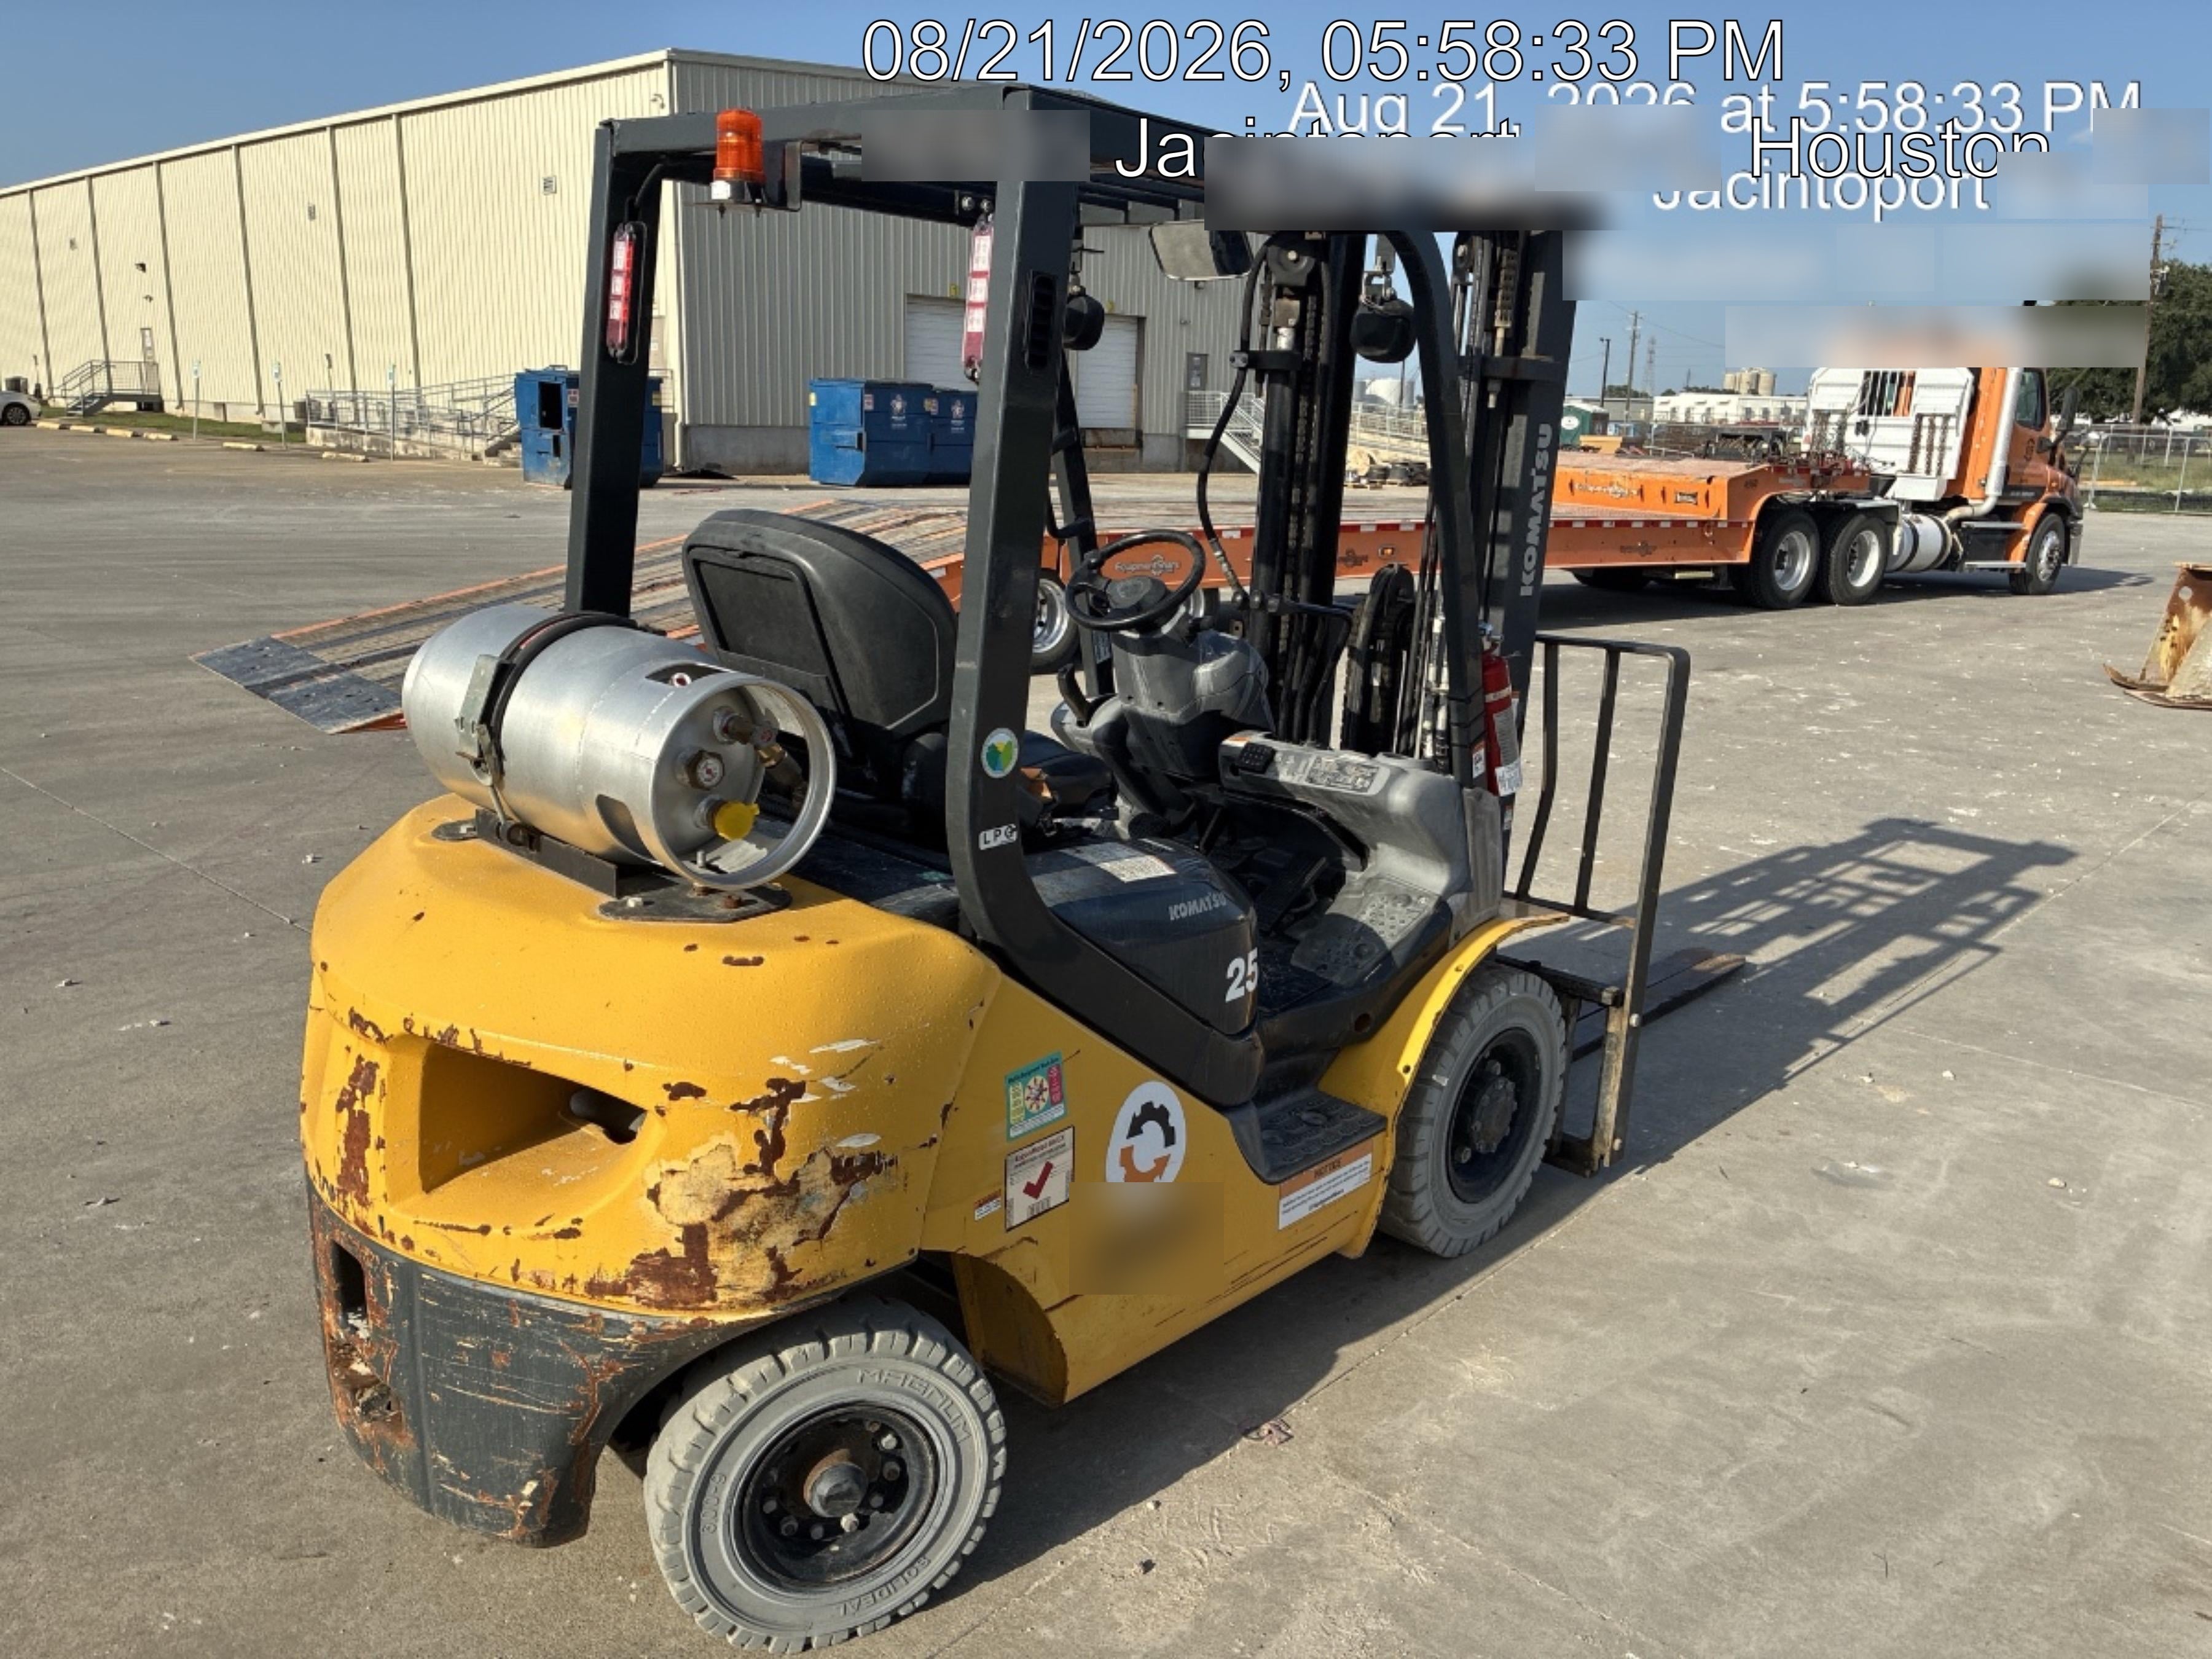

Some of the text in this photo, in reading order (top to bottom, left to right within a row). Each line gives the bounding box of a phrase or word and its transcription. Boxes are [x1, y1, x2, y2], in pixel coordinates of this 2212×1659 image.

[1520, 423, 1553, 596] KOMATSU
[1169, 892, 1227, 920] KOMATSU
[1225, 947, 1258, 1003] 25
